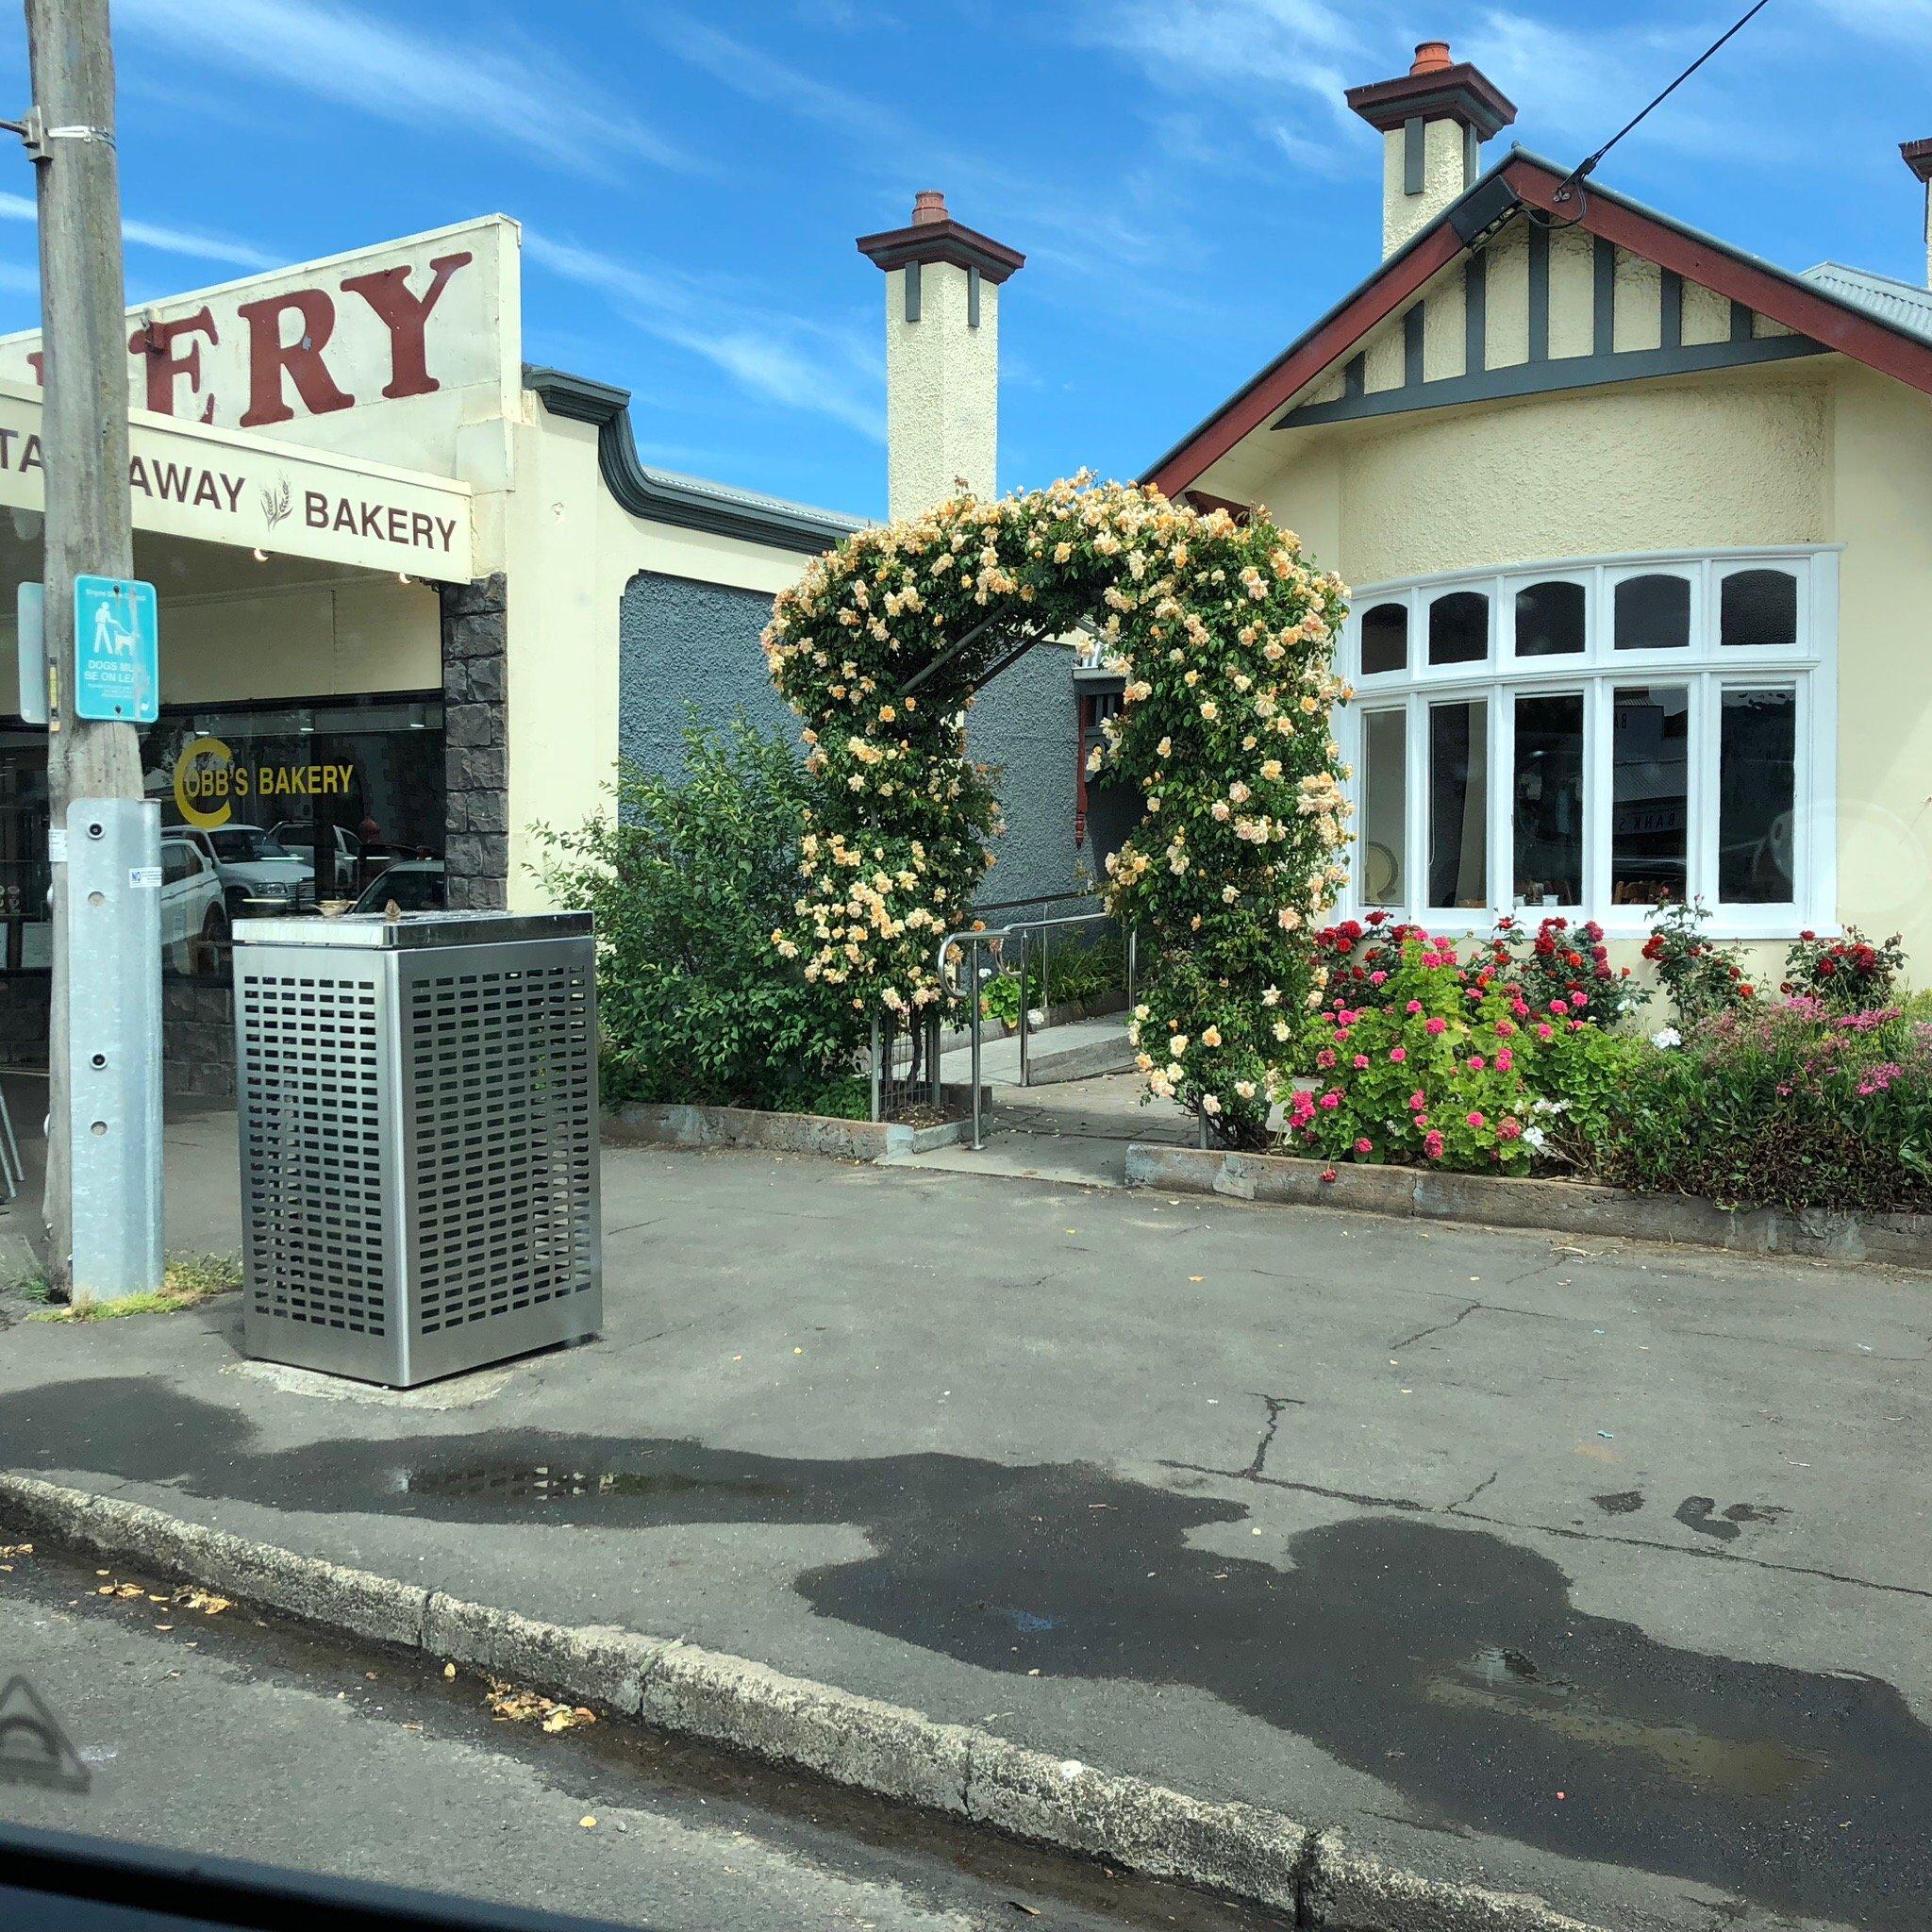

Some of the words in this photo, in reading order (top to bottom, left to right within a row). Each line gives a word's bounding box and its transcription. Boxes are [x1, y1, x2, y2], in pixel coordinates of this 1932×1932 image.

[26, 251, 474, 428] ERY
[305, 490, 457, 552] BAKERY
[84, 670, 99, 681] BE
[100, 672, 116, 682] ON
[88, 659, 118, 672] DOGS
[173, 737, 249, 829] COBB'S
[258, 764, 355, 795] BAKERY
